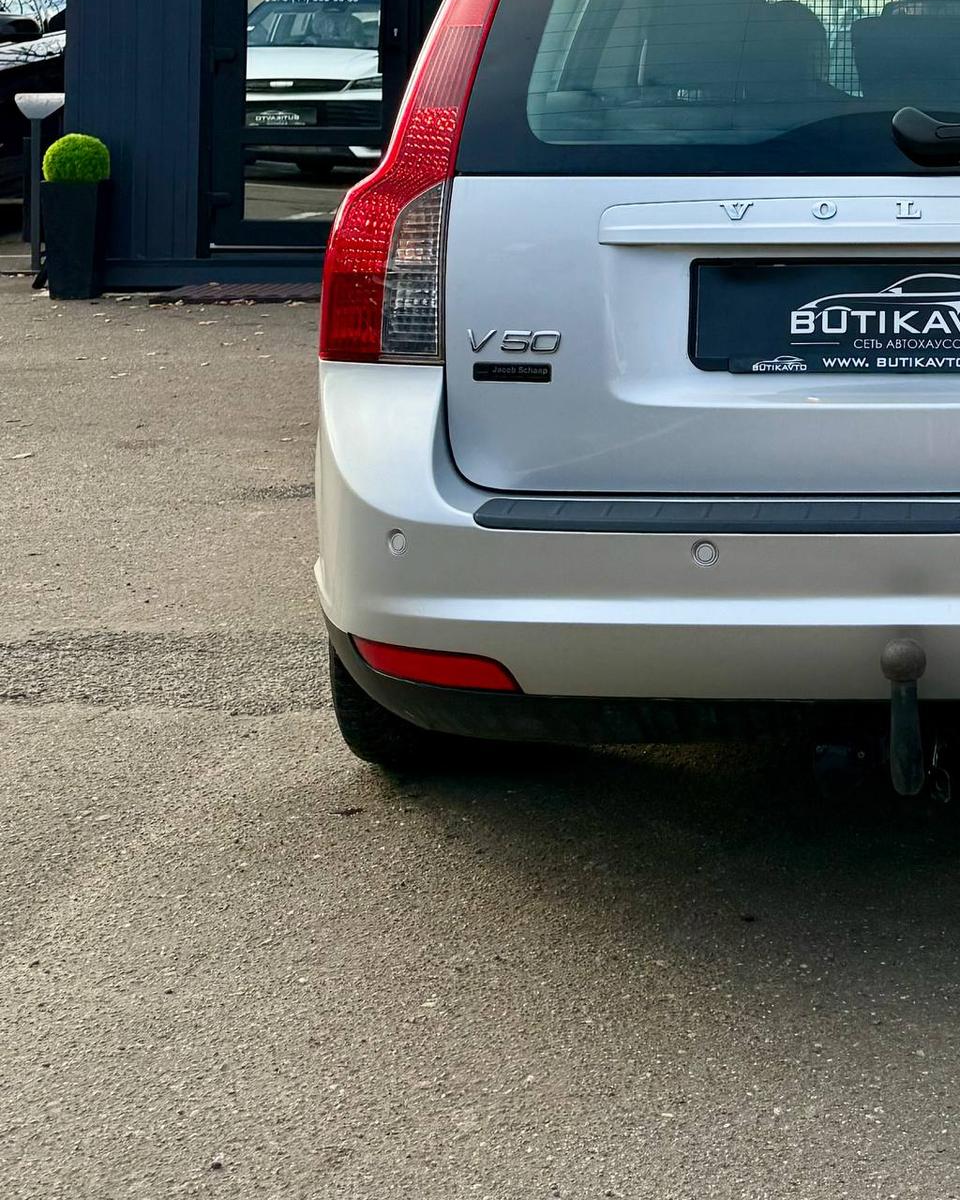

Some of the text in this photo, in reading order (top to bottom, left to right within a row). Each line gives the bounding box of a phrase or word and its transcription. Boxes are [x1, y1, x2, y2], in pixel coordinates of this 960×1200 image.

[853, 338, 883, 349] СЕТЬ
[752, 363, 807, 371] BUTIKAVTO
[822, 357, 869, 368] WWW.
